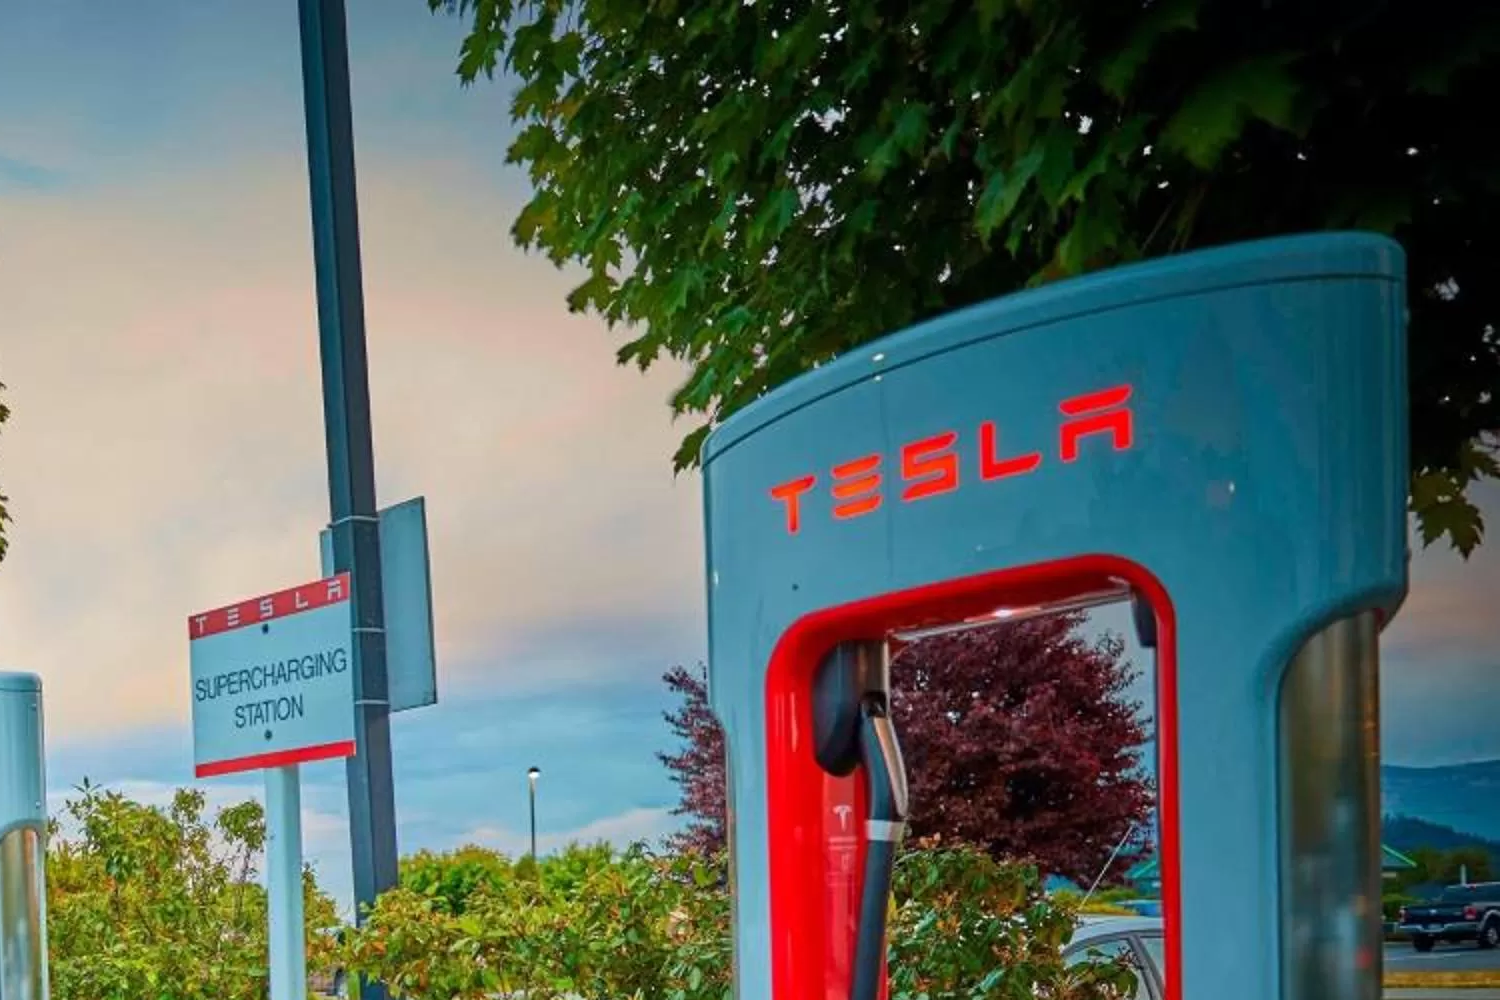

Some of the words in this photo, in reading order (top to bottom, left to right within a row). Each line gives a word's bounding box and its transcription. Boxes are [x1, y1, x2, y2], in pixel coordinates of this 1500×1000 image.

[769, 383, 1134, 534] TESLA
[195, 578, 342, 634] TESLA
[195, 648, 348, 702] SUPERCHARGING
[234, 692, 304, 729] STATION
